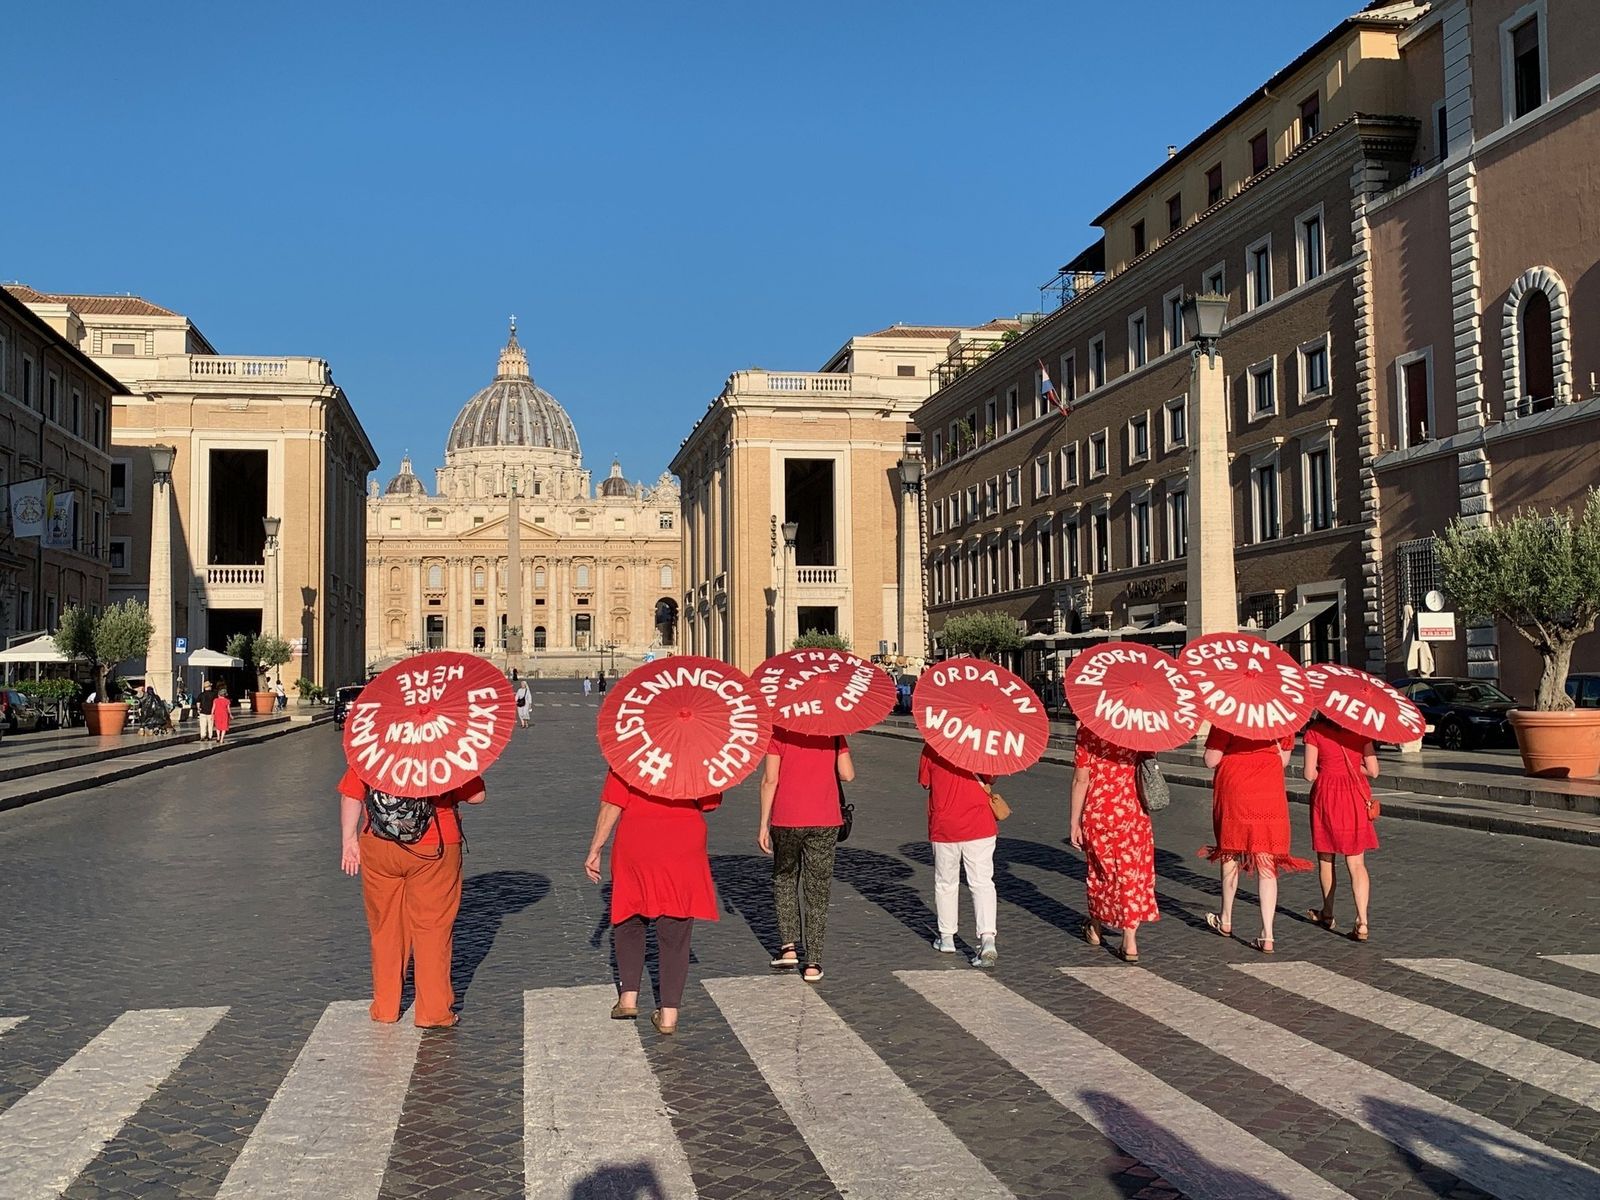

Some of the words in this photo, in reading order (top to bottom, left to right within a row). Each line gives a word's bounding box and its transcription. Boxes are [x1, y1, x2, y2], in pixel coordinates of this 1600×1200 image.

[178, 639, 185, 647] P
[1186, 639, 1270, 666] SEXISM
[790, 652, 863, 667] THAN
[1213, 657, 1238, 671] IS
[1247, 657, 1264, 673] A
[396, 665, 464, 692] HERE
[785, 662, 840, 690] HALF
[933, 665, 1038, 713] ORDAIN
[1074, 649, 1148, 686] REFORM
[1153, 659, 1199, 730] MEANS
[1276, 664, 1305, 704] SIN
[403, 683, 446, 706] ARE
[779, 700, 824, 719] THE
[835, 665, 876, 712] CHURCH
[1095, 689, 1170, 733] WOMEN
[1325, 690, 1386, 732] MEN
[385, 715, 456, 745] WOMEN
[925, 706, 1025, 757] WOMEN
